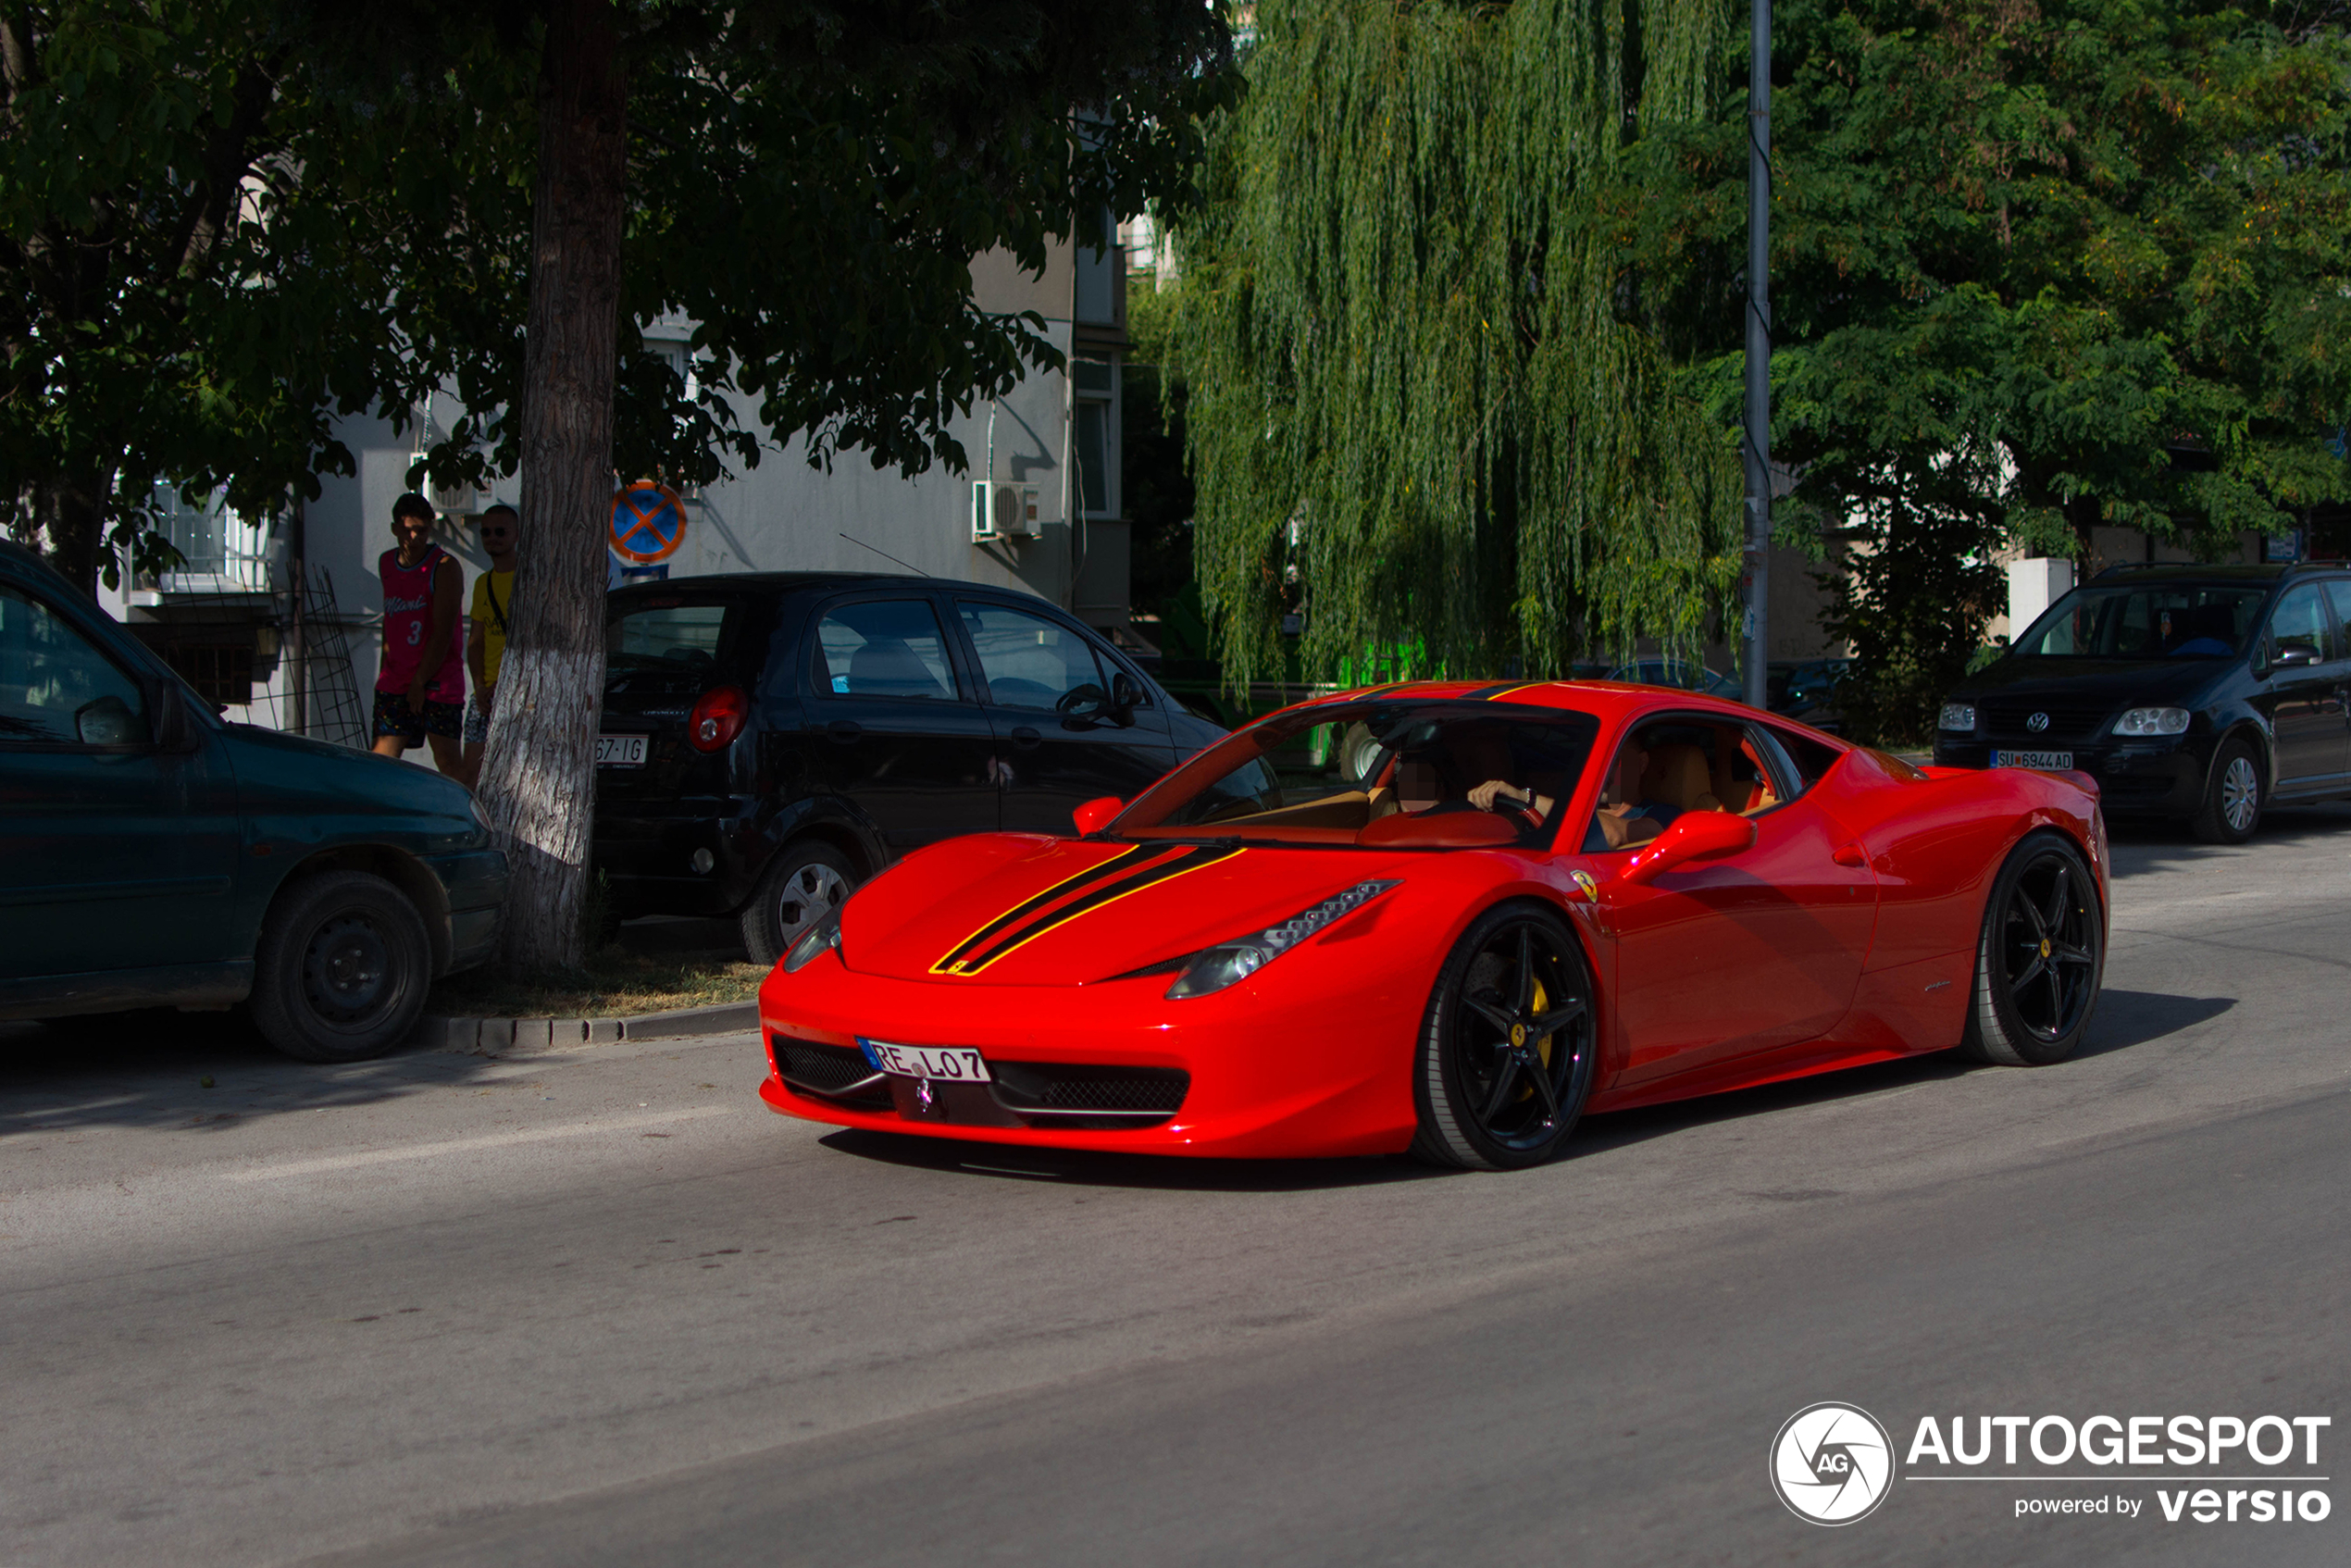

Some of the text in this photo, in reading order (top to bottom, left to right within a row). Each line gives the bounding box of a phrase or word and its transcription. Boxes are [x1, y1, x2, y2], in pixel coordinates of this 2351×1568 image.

[406, 619, 423, 646] 3
[1998, 753, 2014, 766] SU
[871, 1044, 913, 1074] RE
